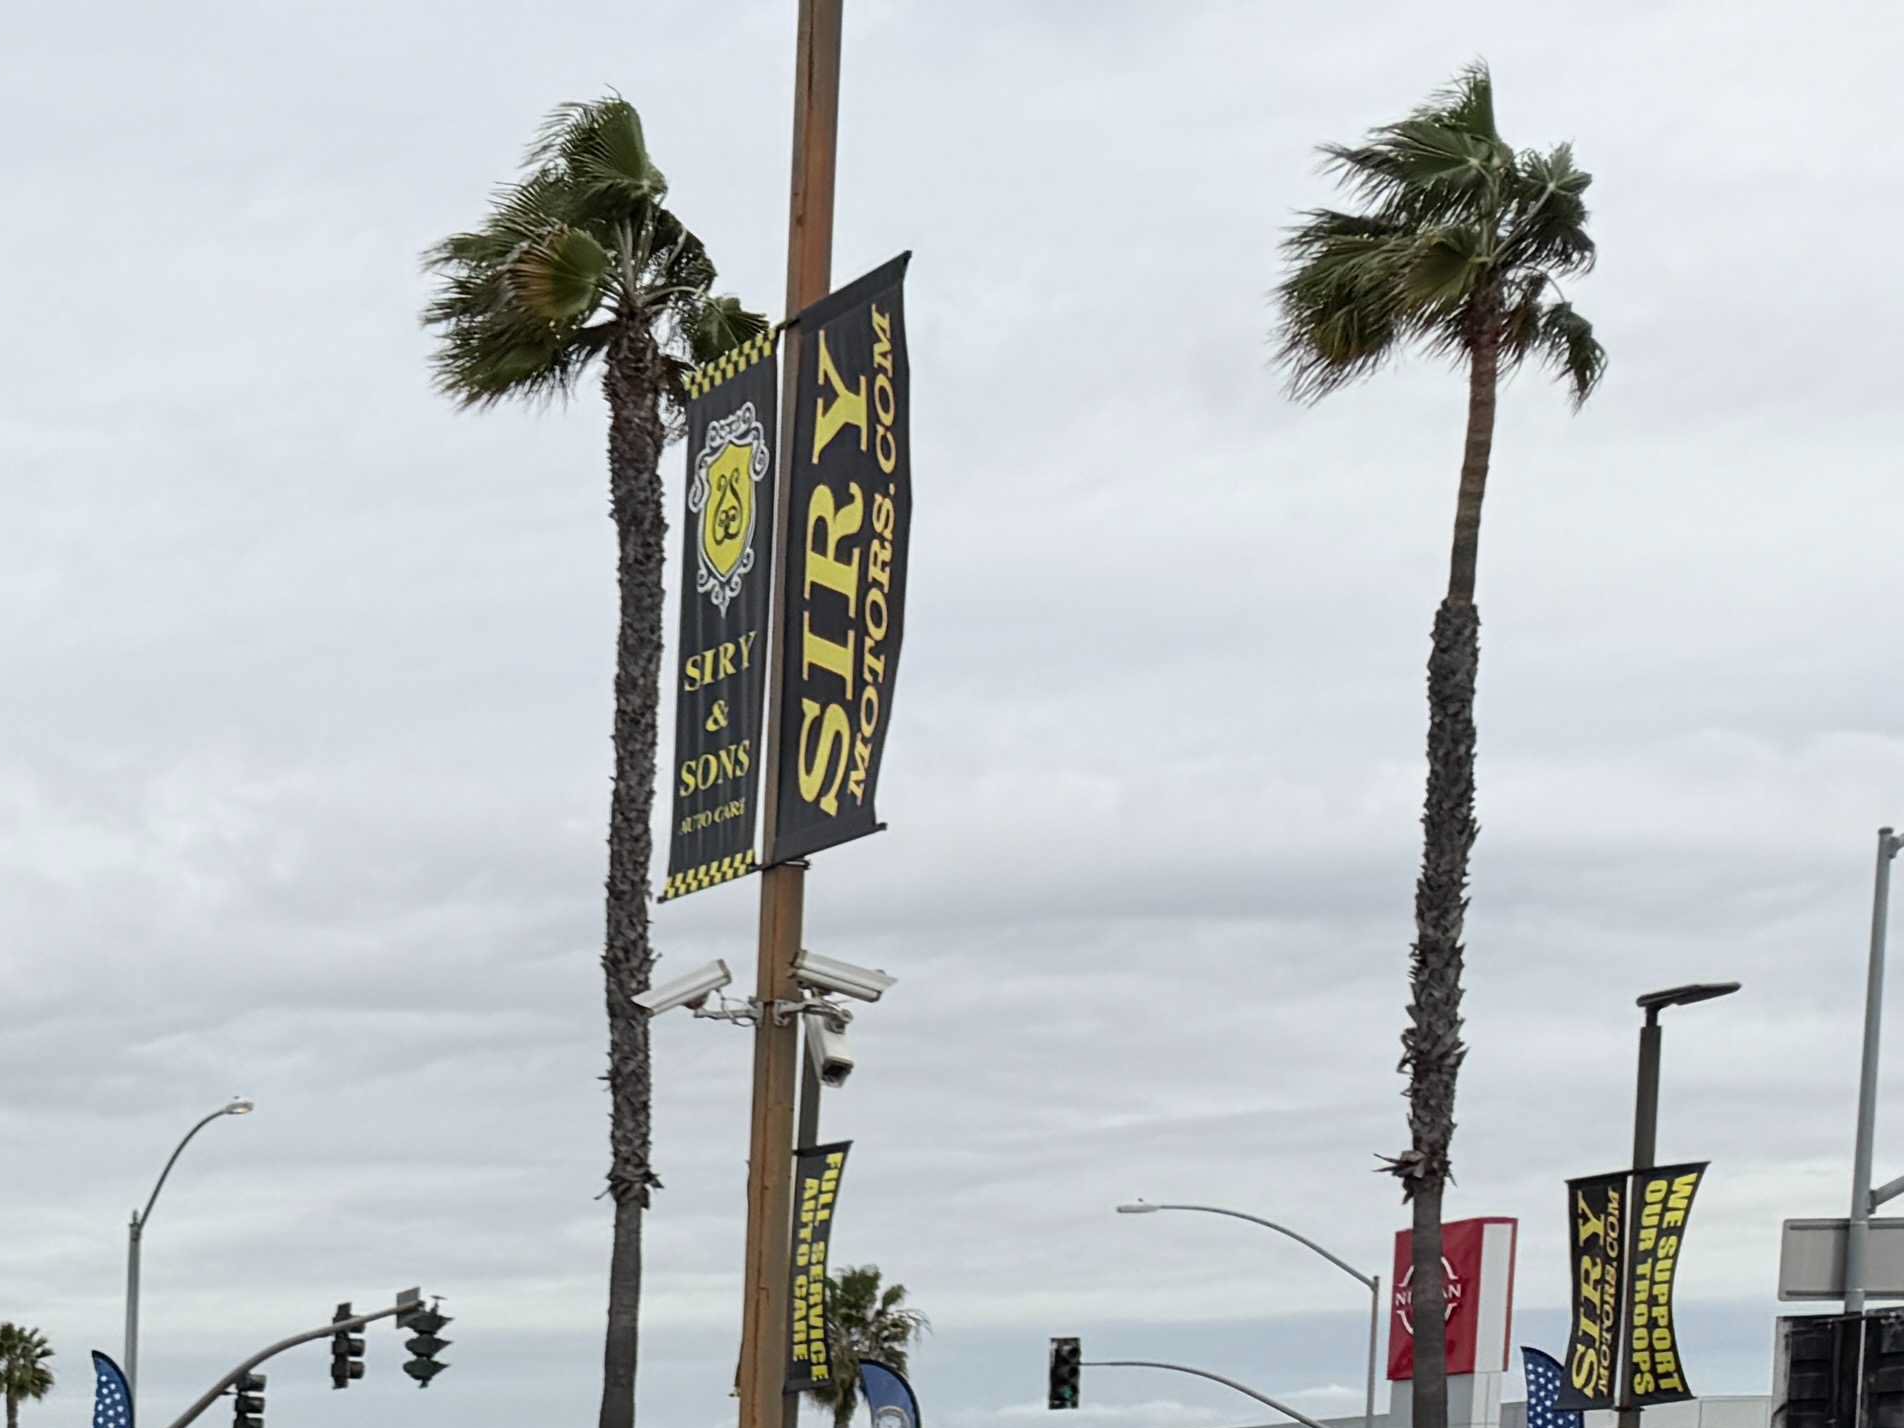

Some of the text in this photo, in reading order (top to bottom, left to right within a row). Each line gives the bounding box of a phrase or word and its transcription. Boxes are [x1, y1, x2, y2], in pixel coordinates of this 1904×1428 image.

[798, 330, 868, 817] SIRY
[848, 303, 897, 806] MOTORS.COM
[684, 631, 757, 692] SIRY
[705, 700, 729, 732] &
[678, 798, 746, 836] AUTO CARE
[679, 739, 751, 797] SONS
[793, 1178, 819, 1361] AUTO CARE
[809, 1152, 844, 1382] FULL SERVICE
[1395, 1284, 1461, 1306] NIN
[1572, 1189, 1604, 1400] SIRY
[1598, 1187, 1620, 1396] MOTORS.COM
[1632, 1179, 1668, 1395] OUR TROOPS
[1652, 1173, 1698, 1393] WE SUPPORT
